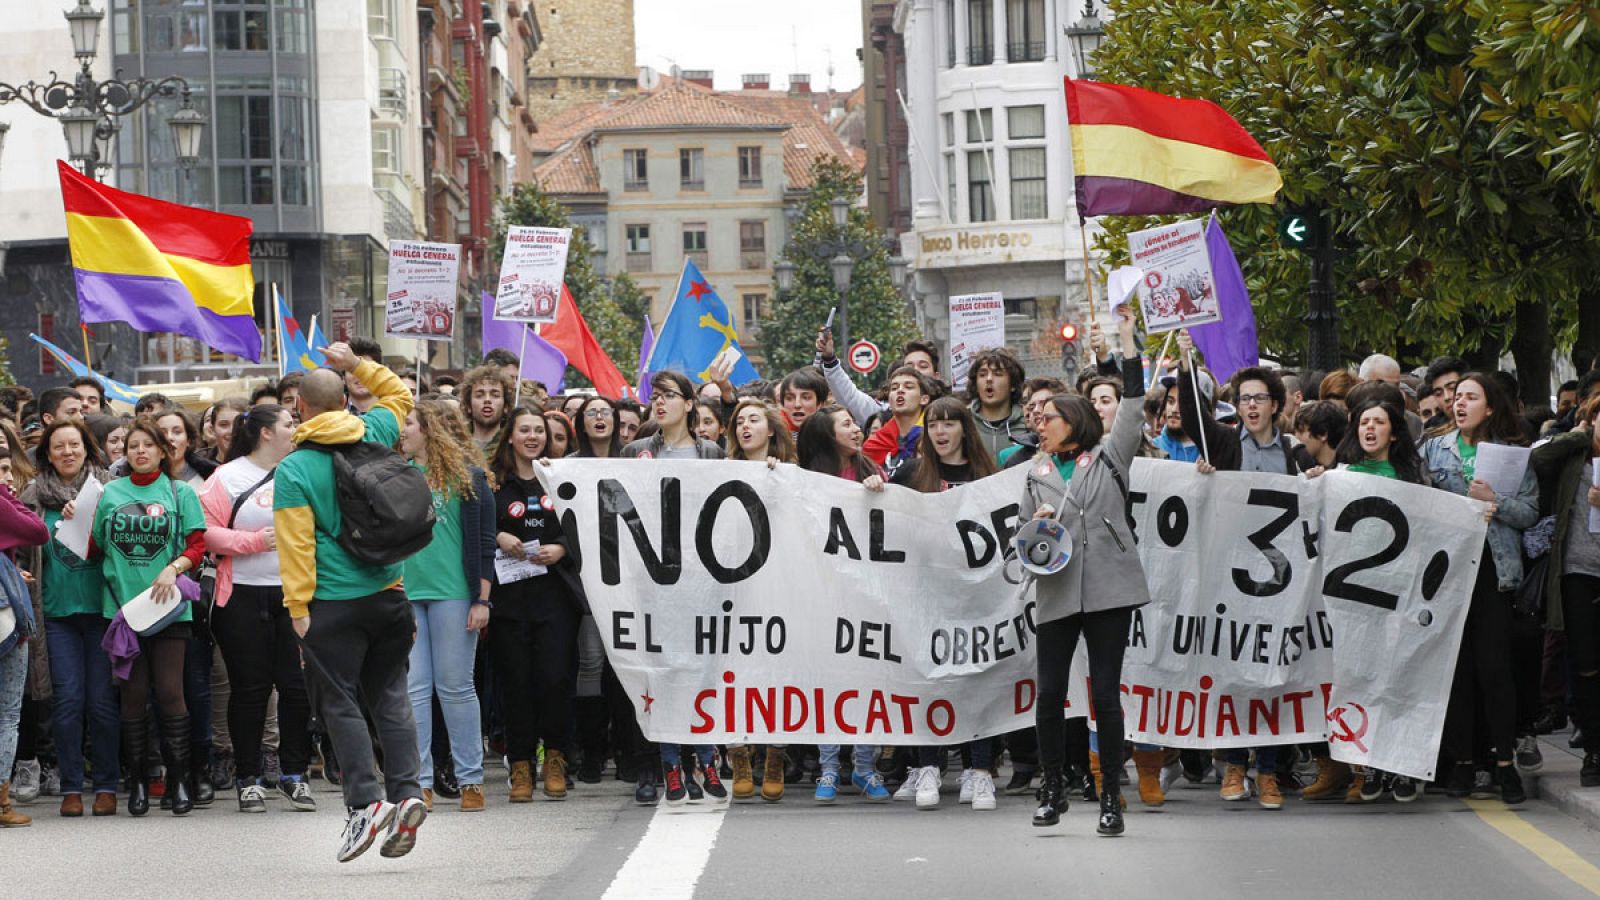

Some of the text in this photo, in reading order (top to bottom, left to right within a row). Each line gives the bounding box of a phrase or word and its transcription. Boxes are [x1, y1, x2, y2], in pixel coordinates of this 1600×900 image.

[510, 234, 566, 244] HUELGA GENERAL
[957, 231, 1032, 250] Herrero
[253, 241, 288, 257] ANTE
[392, 249, 456, 260] HUELGA GENERAL
[952, 301, 1001, 312] HUELGA GENERAL
[114, 513, 166, 532] STOP
[114, 533, 165, 544] DESAHUCIOS
[824, 506, 906, 563] AL
[612, 611, 663, 653] EL
[835, 616, 902, 664] DEL
[1125, 609, 1148, 648] A
